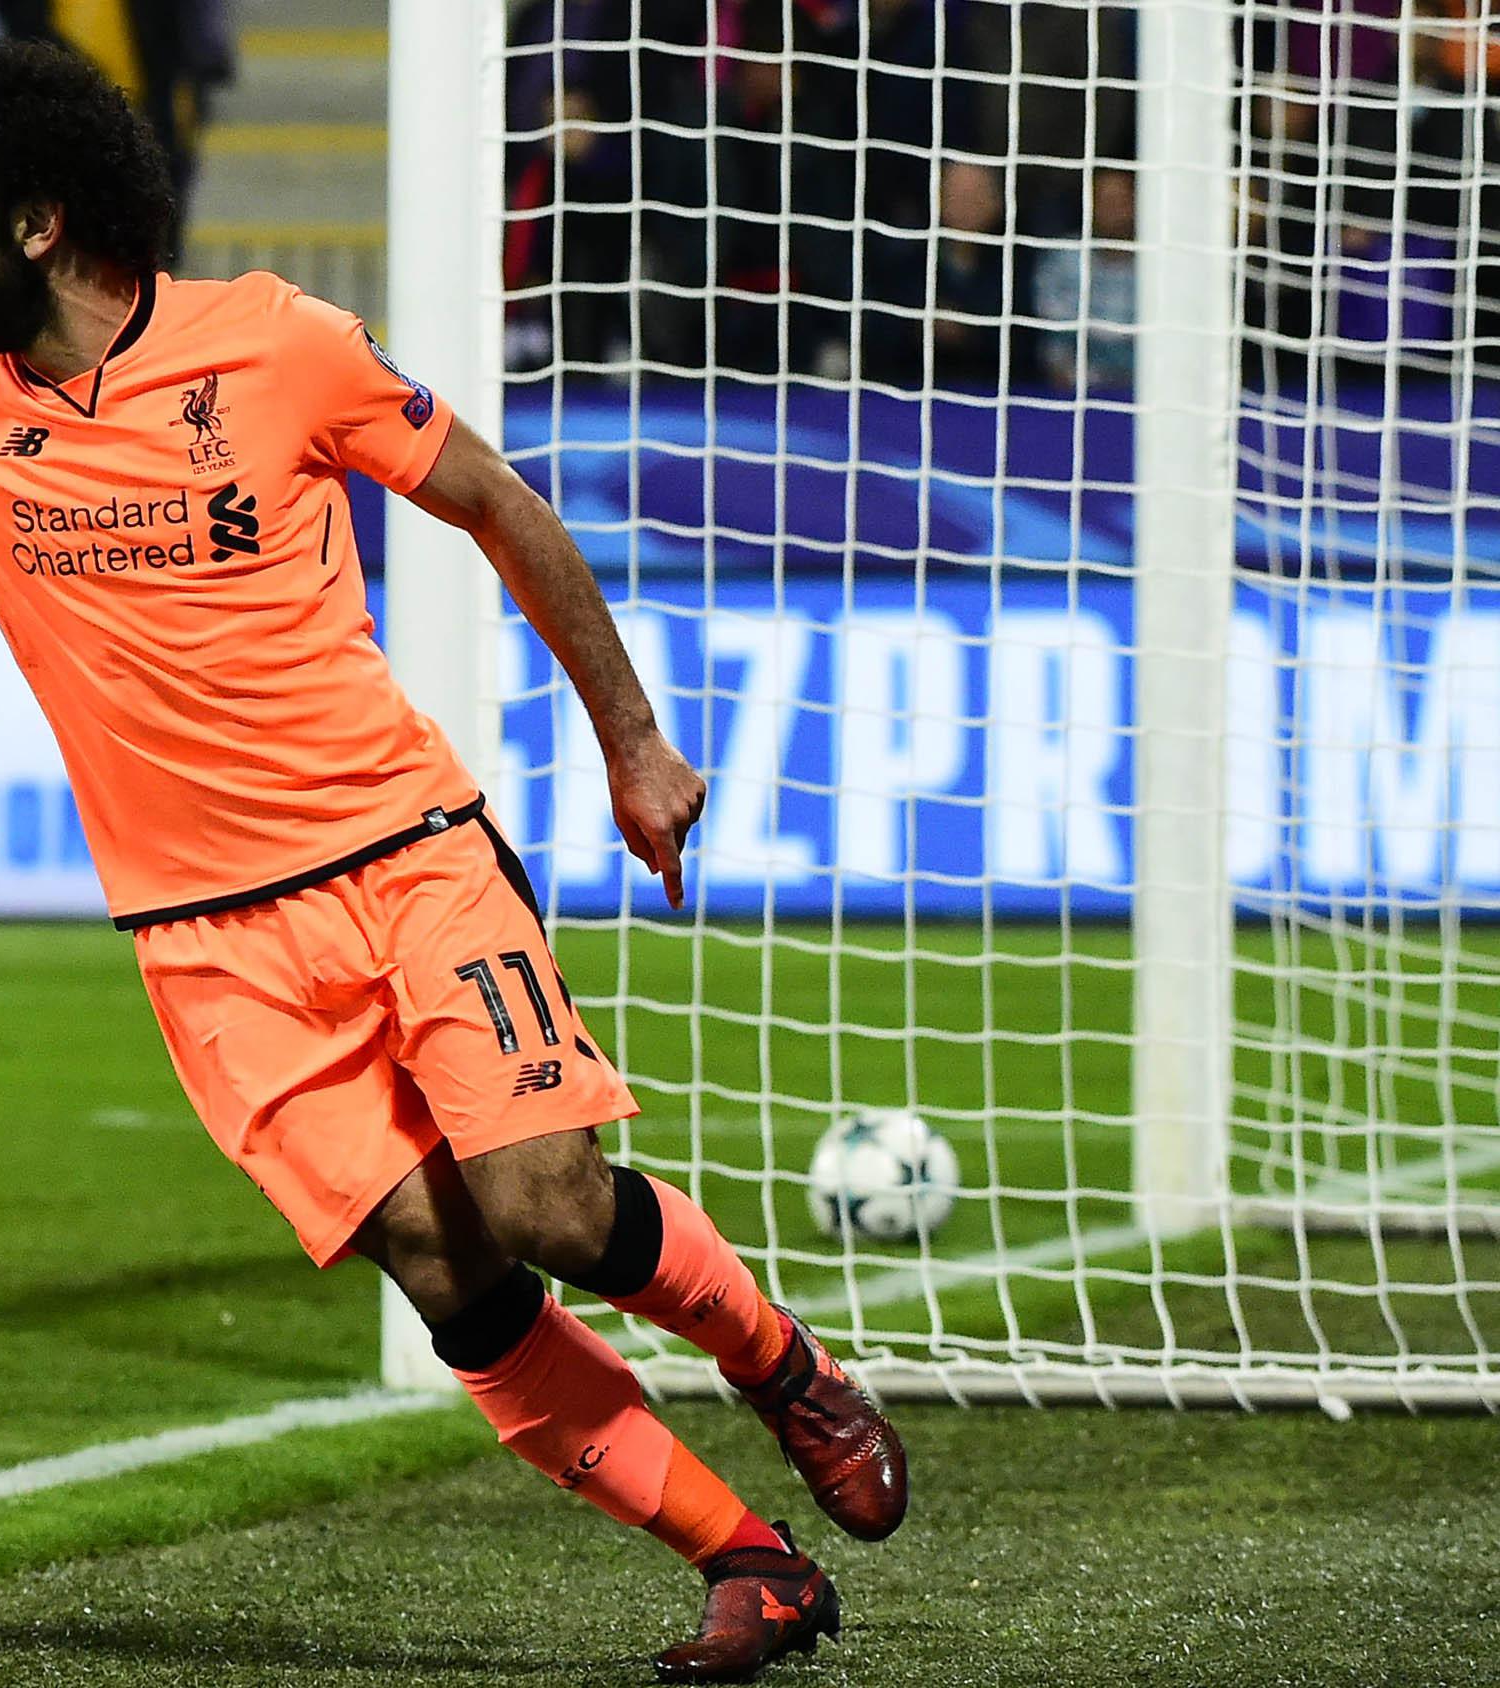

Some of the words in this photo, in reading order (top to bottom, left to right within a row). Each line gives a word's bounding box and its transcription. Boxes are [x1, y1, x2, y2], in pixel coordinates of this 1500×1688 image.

[208, 458, 236, 473] YEARS
[12, 490, 189, 533] Standard
[12, 534, 195, 577] Chartered
[453, 950, 561, 1056] 11
